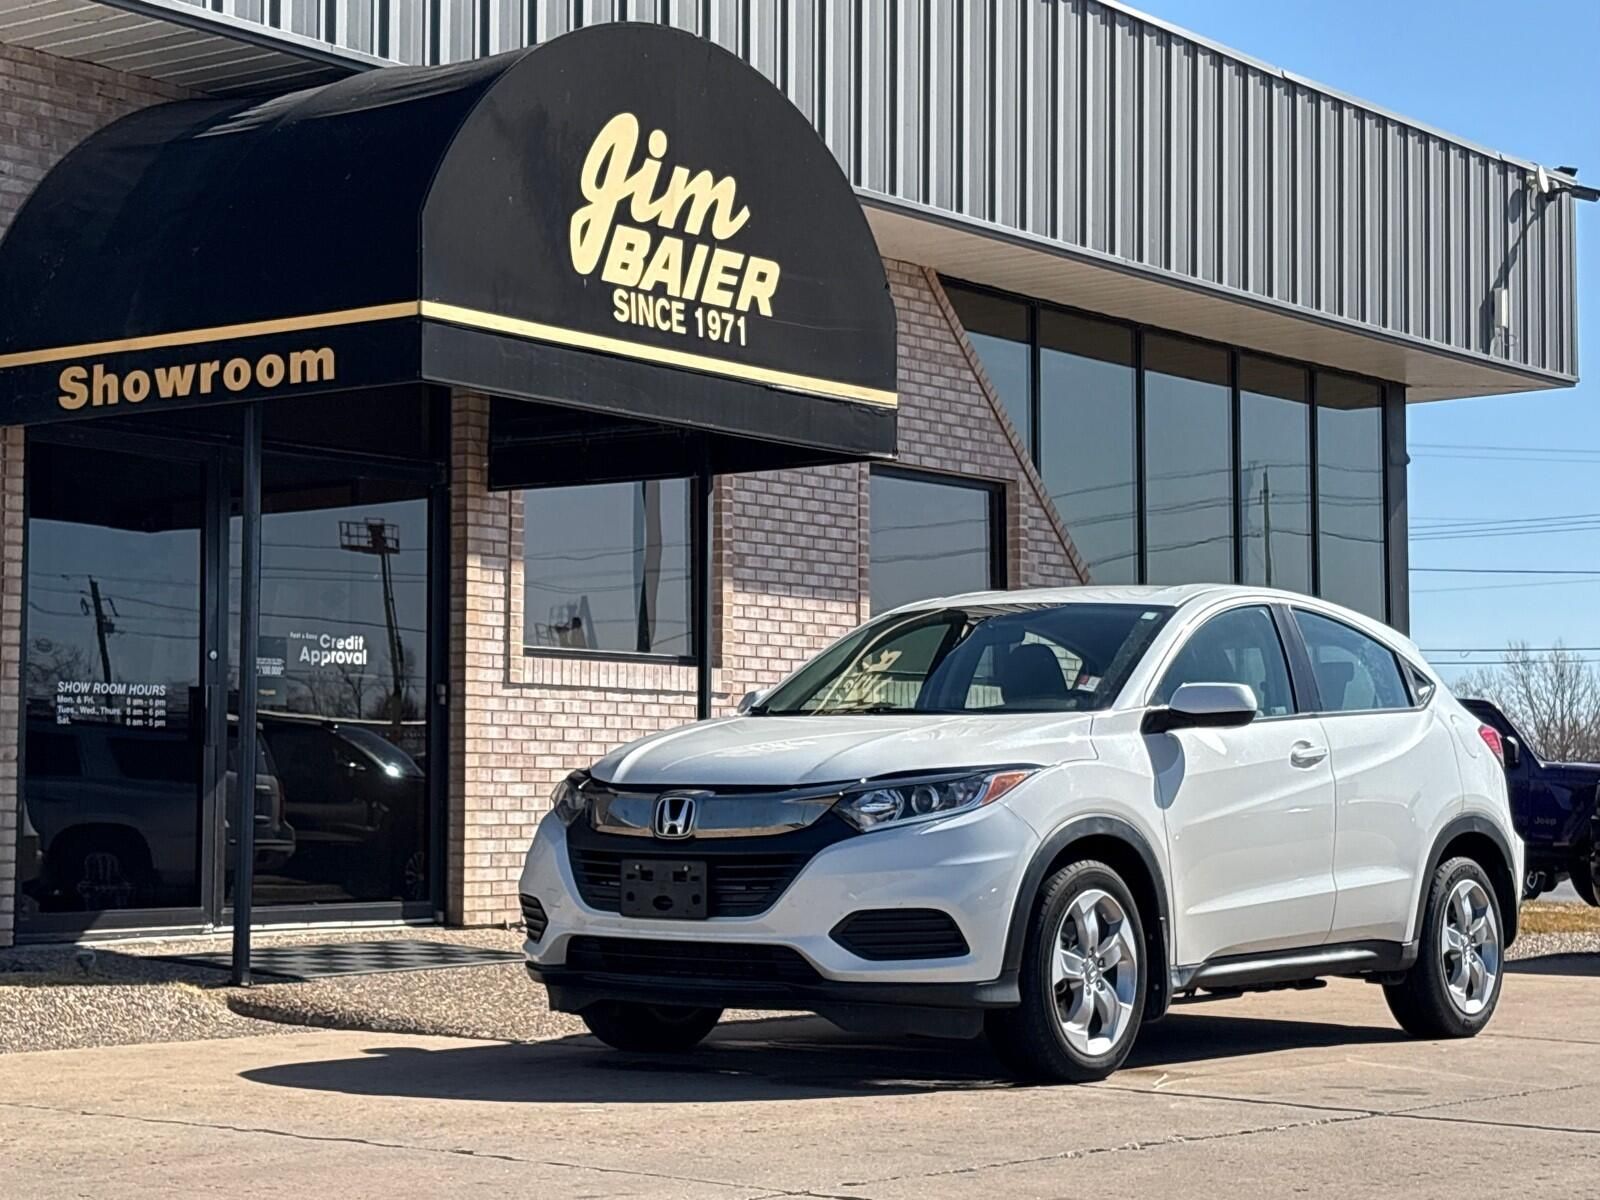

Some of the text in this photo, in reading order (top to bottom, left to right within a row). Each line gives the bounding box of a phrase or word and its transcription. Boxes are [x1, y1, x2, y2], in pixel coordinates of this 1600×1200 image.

[570, 112, 750, 275] Jim
[601, 224, 780, 317] BAIER
[613, 288, 746, 346] SINCE 1971
[58, 347, 335, 410] Showroom
[320, 633, 364, 650] Credit
[299, 646, 367, 667] Approval
[57, 681, 167, 696] SHOW ROOM HOURS
[57, 694, 75, 704] Mon.
[132, 698, 143, 706] am
[154, 699, 166, 708] pm
[154, 709, 166, 718] pm
[154, 720, 166, 728] pm
[1534, 816, 1557, 827] Jeep
